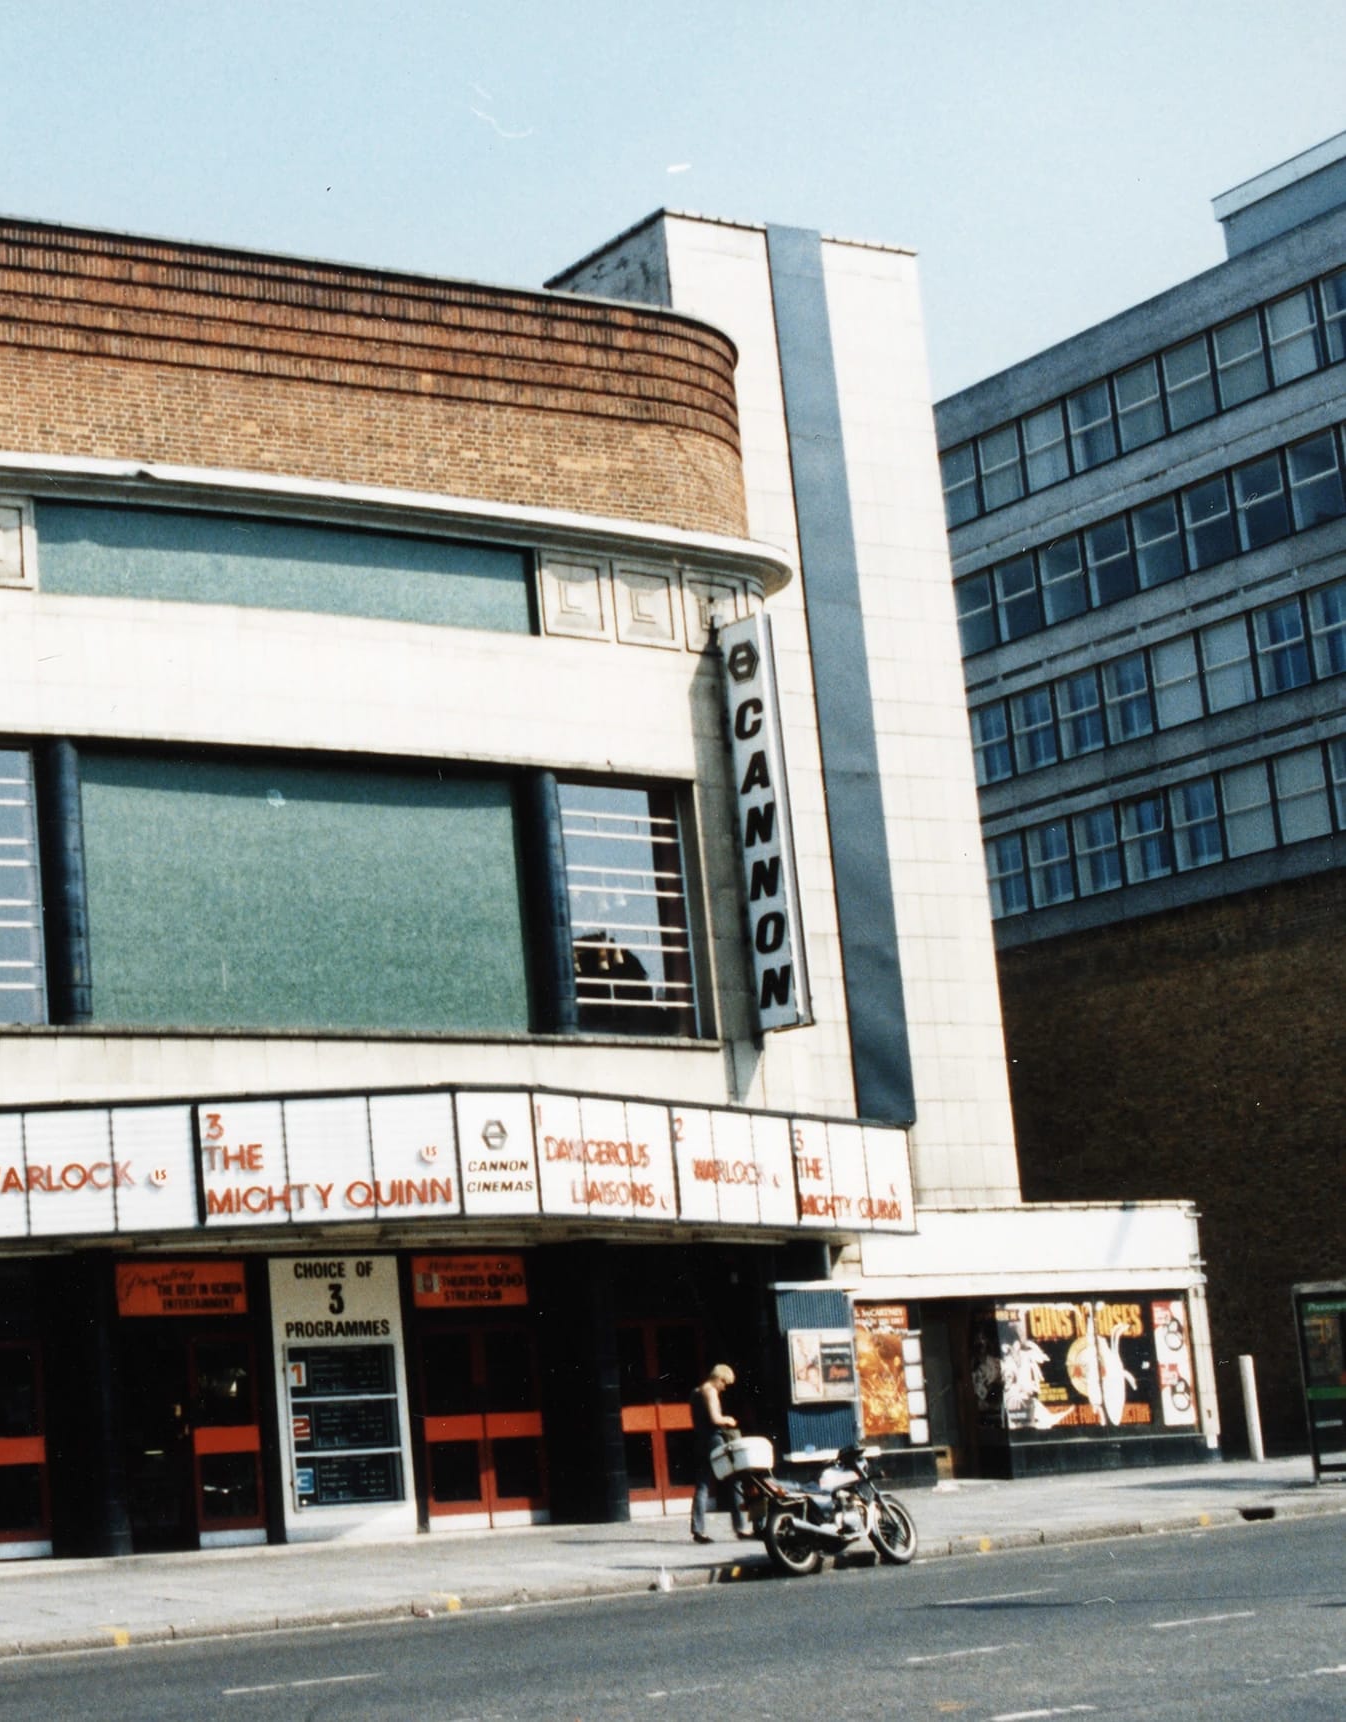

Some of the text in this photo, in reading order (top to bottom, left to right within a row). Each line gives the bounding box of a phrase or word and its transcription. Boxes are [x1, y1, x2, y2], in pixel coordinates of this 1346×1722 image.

[734, 696, 792, 1009] CANNON
[205, 1113, 225, 1140] 3
[673, 1117, 684, 1142] 2
[793, 1128, 805, 1151] 3
[203, 1143, 264, 1171] THE
[467, 1160, 530, 1173] CANNON
[797, 1155, 825, 1180] THE
[205, 1177, 453, 1215] MIGHTY QUINN
[466, 1180, 533, 1194] CINEMAS
[570, 1176, 655, 1209] LIAISONS
[858, 1197, 902, 1221] QUINN
[293, 1260, 374, 1279] CHOICE OF
[328, 1283, 345, 1315] 3
[285, 1319, 390, 1338] PROGRAMMES
[1029, 1306, 1073, 1339] GUNS
[290, 1364, 303, 1384] 1
[292, 1417, 310, 1439] 2
